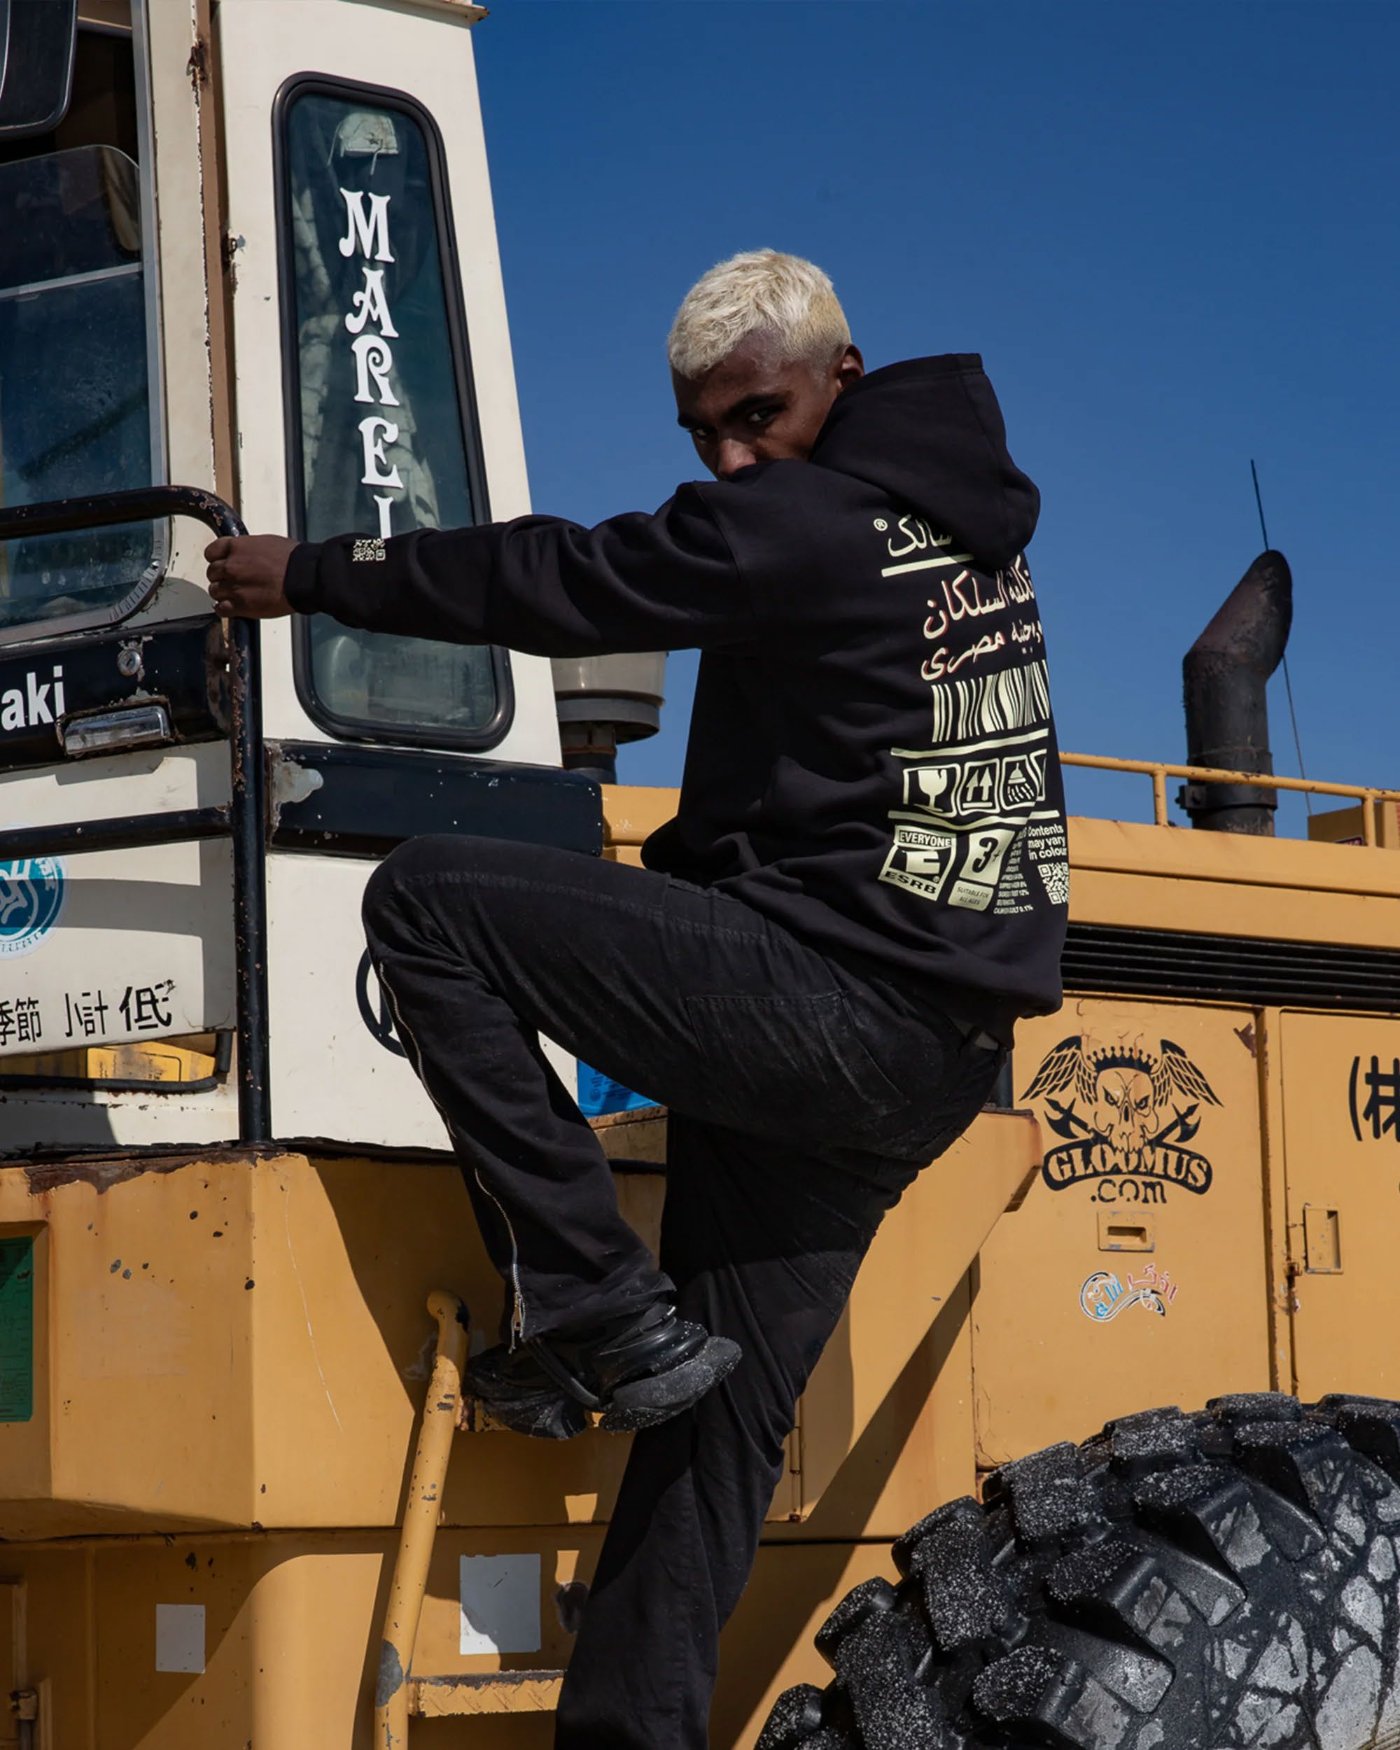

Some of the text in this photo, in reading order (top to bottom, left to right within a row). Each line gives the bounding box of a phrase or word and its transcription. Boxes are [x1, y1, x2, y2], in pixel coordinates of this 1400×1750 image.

[1, 665, 65, 731] aki
[900, 831, 952, 848] EVERYONE
[1046, 836, 1066, 847] vary
[1028, 849, 1038, 861] in
[885, 870, 937, 894] ESRB
[1047, 1143, 1208, 1190] GLOOMUS
